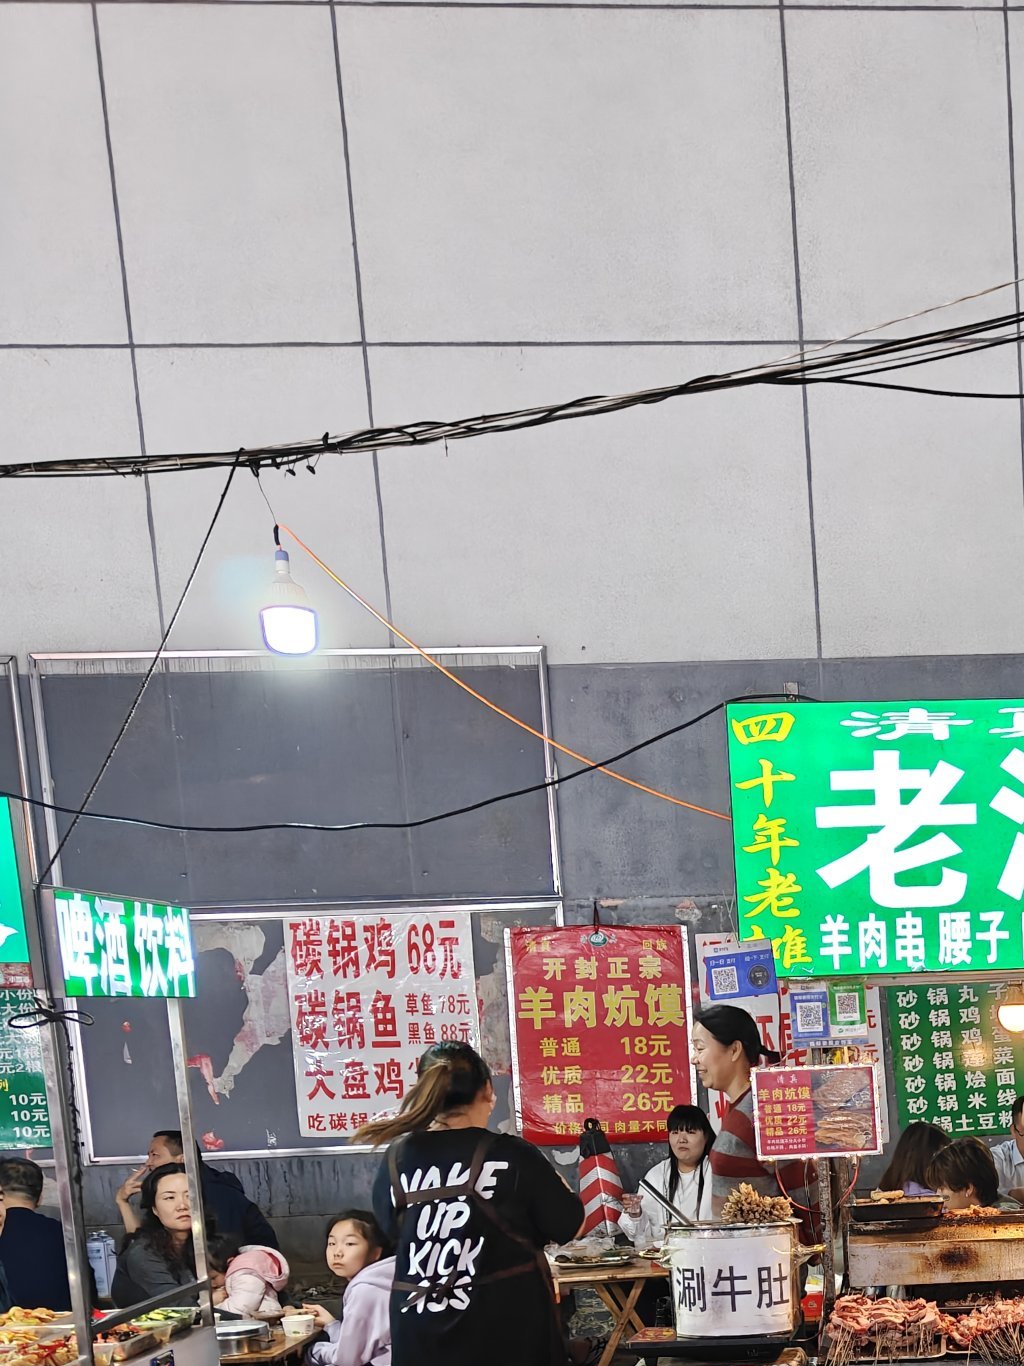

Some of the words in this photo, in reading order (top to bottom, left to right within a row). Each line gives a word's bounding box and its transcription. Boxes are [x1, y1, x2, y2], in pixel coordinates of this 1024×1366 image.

[55, 892, 132, 997] 啤酒
[133, 901, 195, 998] 饮料
[289, 917, 397, 980] 碳锅鸡
[407, 919, 462, 981] 68元
[642, 938, 668, 951] 回族
[819, 911, 925, 970] 羊肉串
[938, 910, 1010, 966] 腰子
[542, 955, 663, 981] 开封正宗
[518, 983, 685, 1030] 羊肉炕馍
[896, 983, 1007, 1009] 砂锅丸子
[294, 988, 402, 1050] 碳锅鱼
[405, 993, 436, 1016] 草鱼
[440, 993, 470, 1015] 78元
[898, 1006, 997, 1030] 砂锅鸡
[408, 1022, 436, 1046] 黑鱼
[440, 1022, 471, 1043] 88元
[540, 1037, 582, 1057] 普通
[620, 1034, 672, 1057] 18元
[304, 1057, 404, 1101] 大盘鸡
[541, 1066, 583, 1086] 优质
[620, 1063, 673, 1085] 22元
[904, 1067, 1015, 1093] 砂锅烩面
[9, 1094, 46, 1106] 10元
[543, 1093, 584, 1114] 精品
[622, 1091, 674, 1113] 26元
[758, 1086, 811, 1101] 羊肉炕馍
[907, 1089, 1017, 1114] 砂锅米线
[11, 1110, 48, 1122] 10元
[786, 1103, 806, 1112] 18元
[13, 1126, 50, 1138] 10元
[554, 1121, 609, 1135] 价格同
[614, 1120, 667, 1134] 肉量不同
[787, 1115, 807, 1125] 22元
[788, 1126, 808, 1135] 26元
[909, 1112, 1013, 1133] 锅土豆粉
[416, 1201, 471, 1240] UP
[407, 1236, 485, 1278] KICK
[676, 1264, 790, 1313] 涮牛肚
